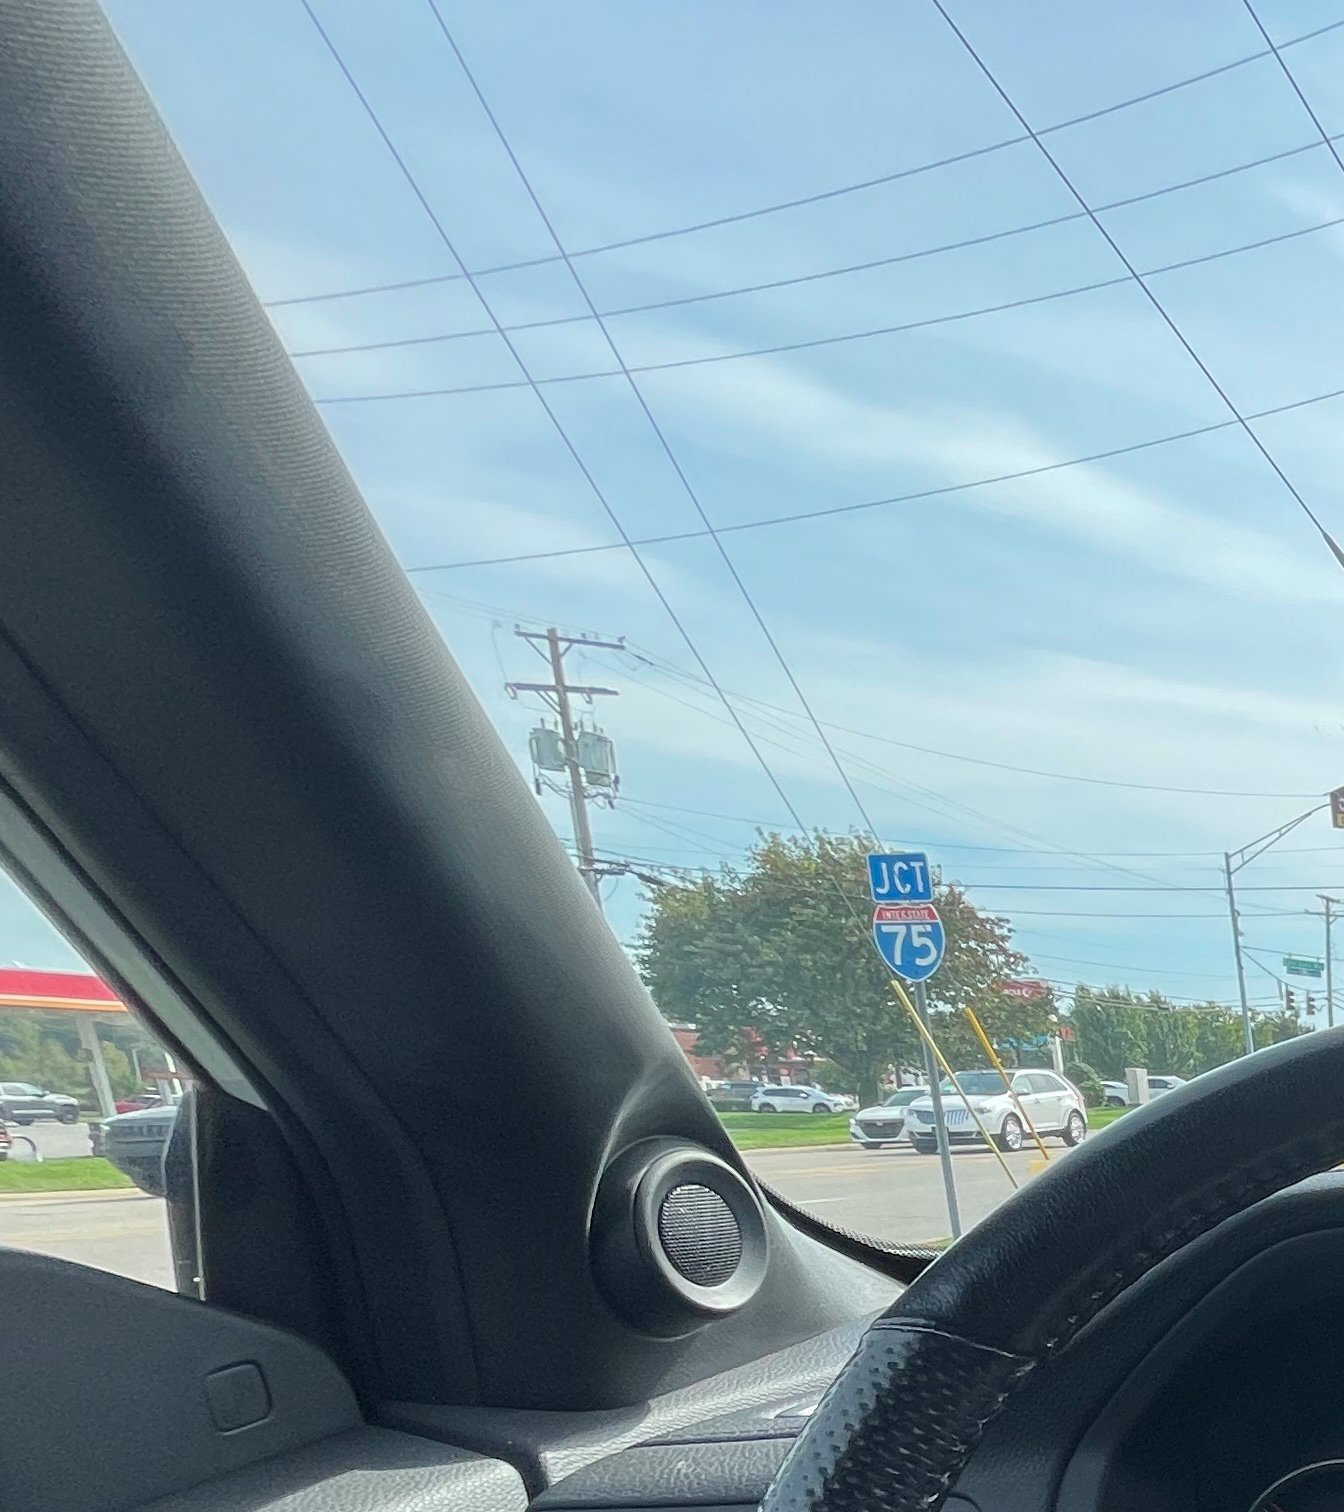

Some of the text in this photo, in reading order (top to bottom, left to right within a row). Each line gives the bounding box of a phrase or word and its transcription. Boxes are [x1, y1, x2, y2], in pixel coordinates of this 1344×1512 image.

[876, 861, 926, 894] JCT
[881, 909, 931, 921] INTERSTATE
[881, 924, 938, 967] 75
